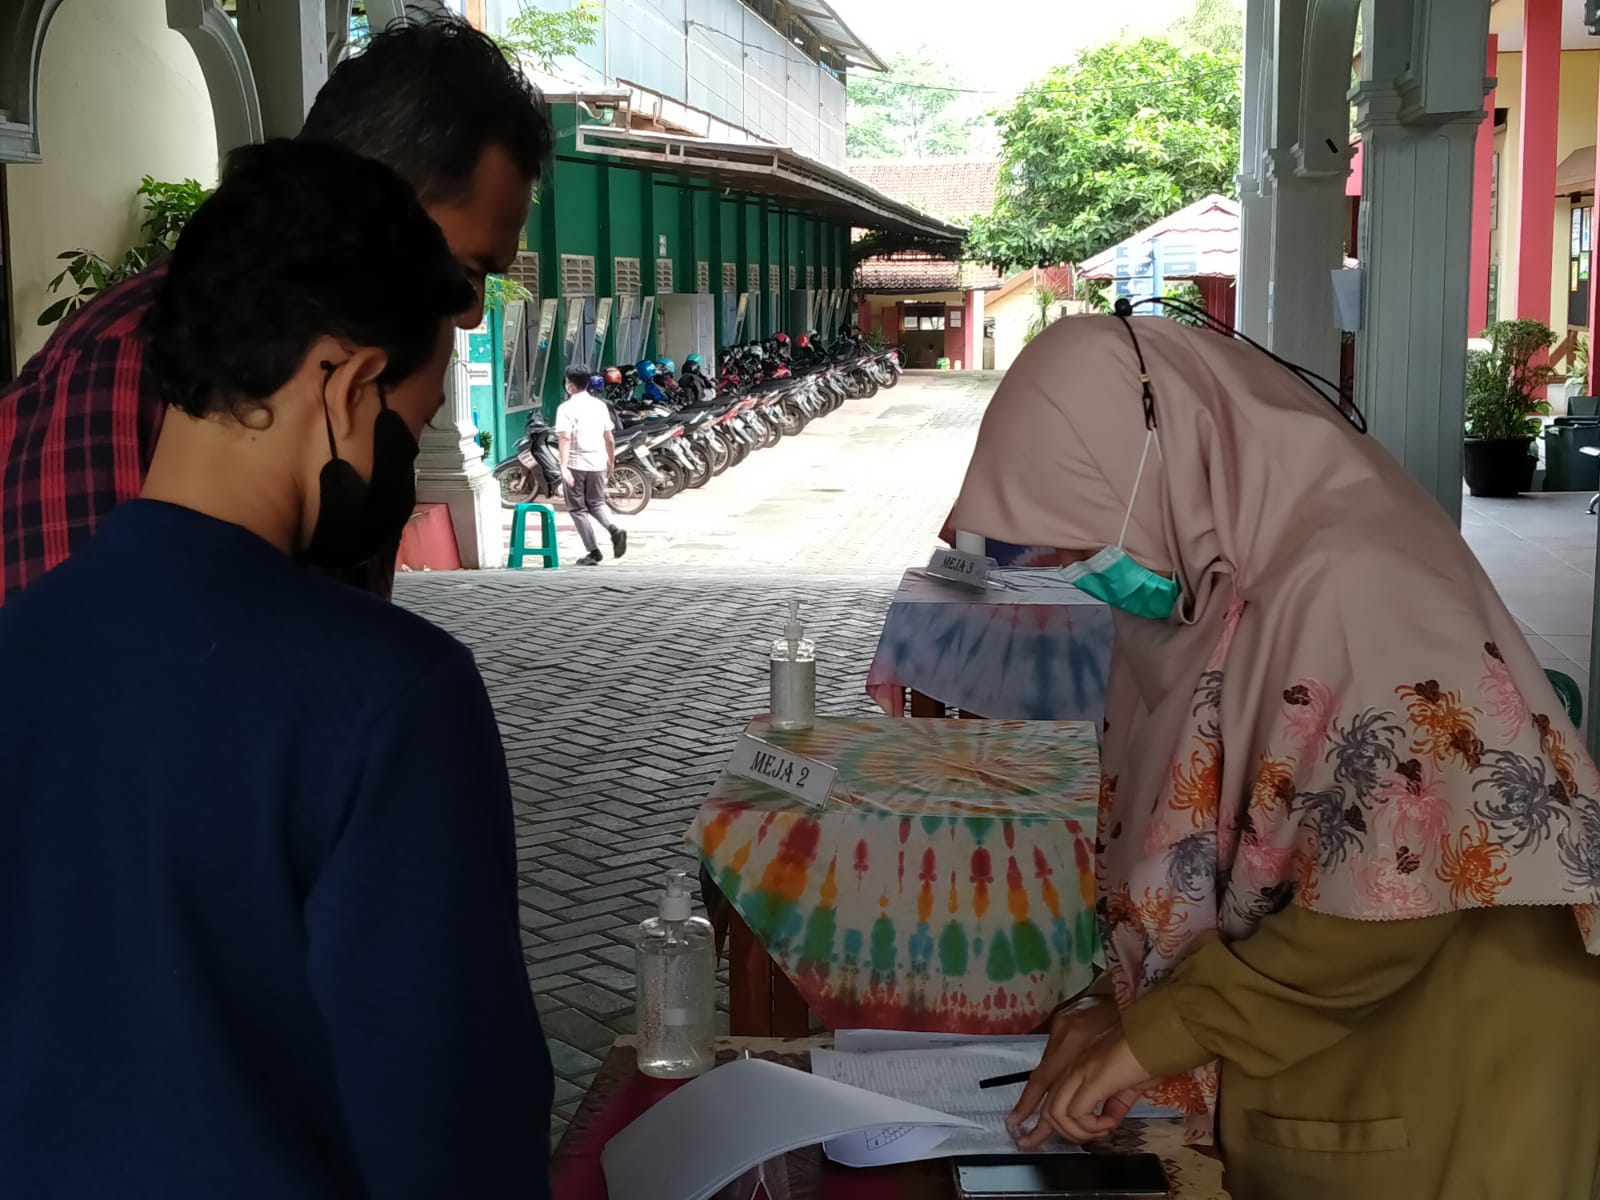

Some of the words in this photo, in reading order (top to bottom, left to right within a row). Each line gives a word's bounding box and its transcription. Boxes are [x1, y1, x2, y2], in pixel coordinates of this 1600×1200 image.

[943, 555, 965, 573] MEJA
[966, 561, 975, 575] 3
[750, 750, 794, 784] MEJA
[796, 766, 810, 787] 2
